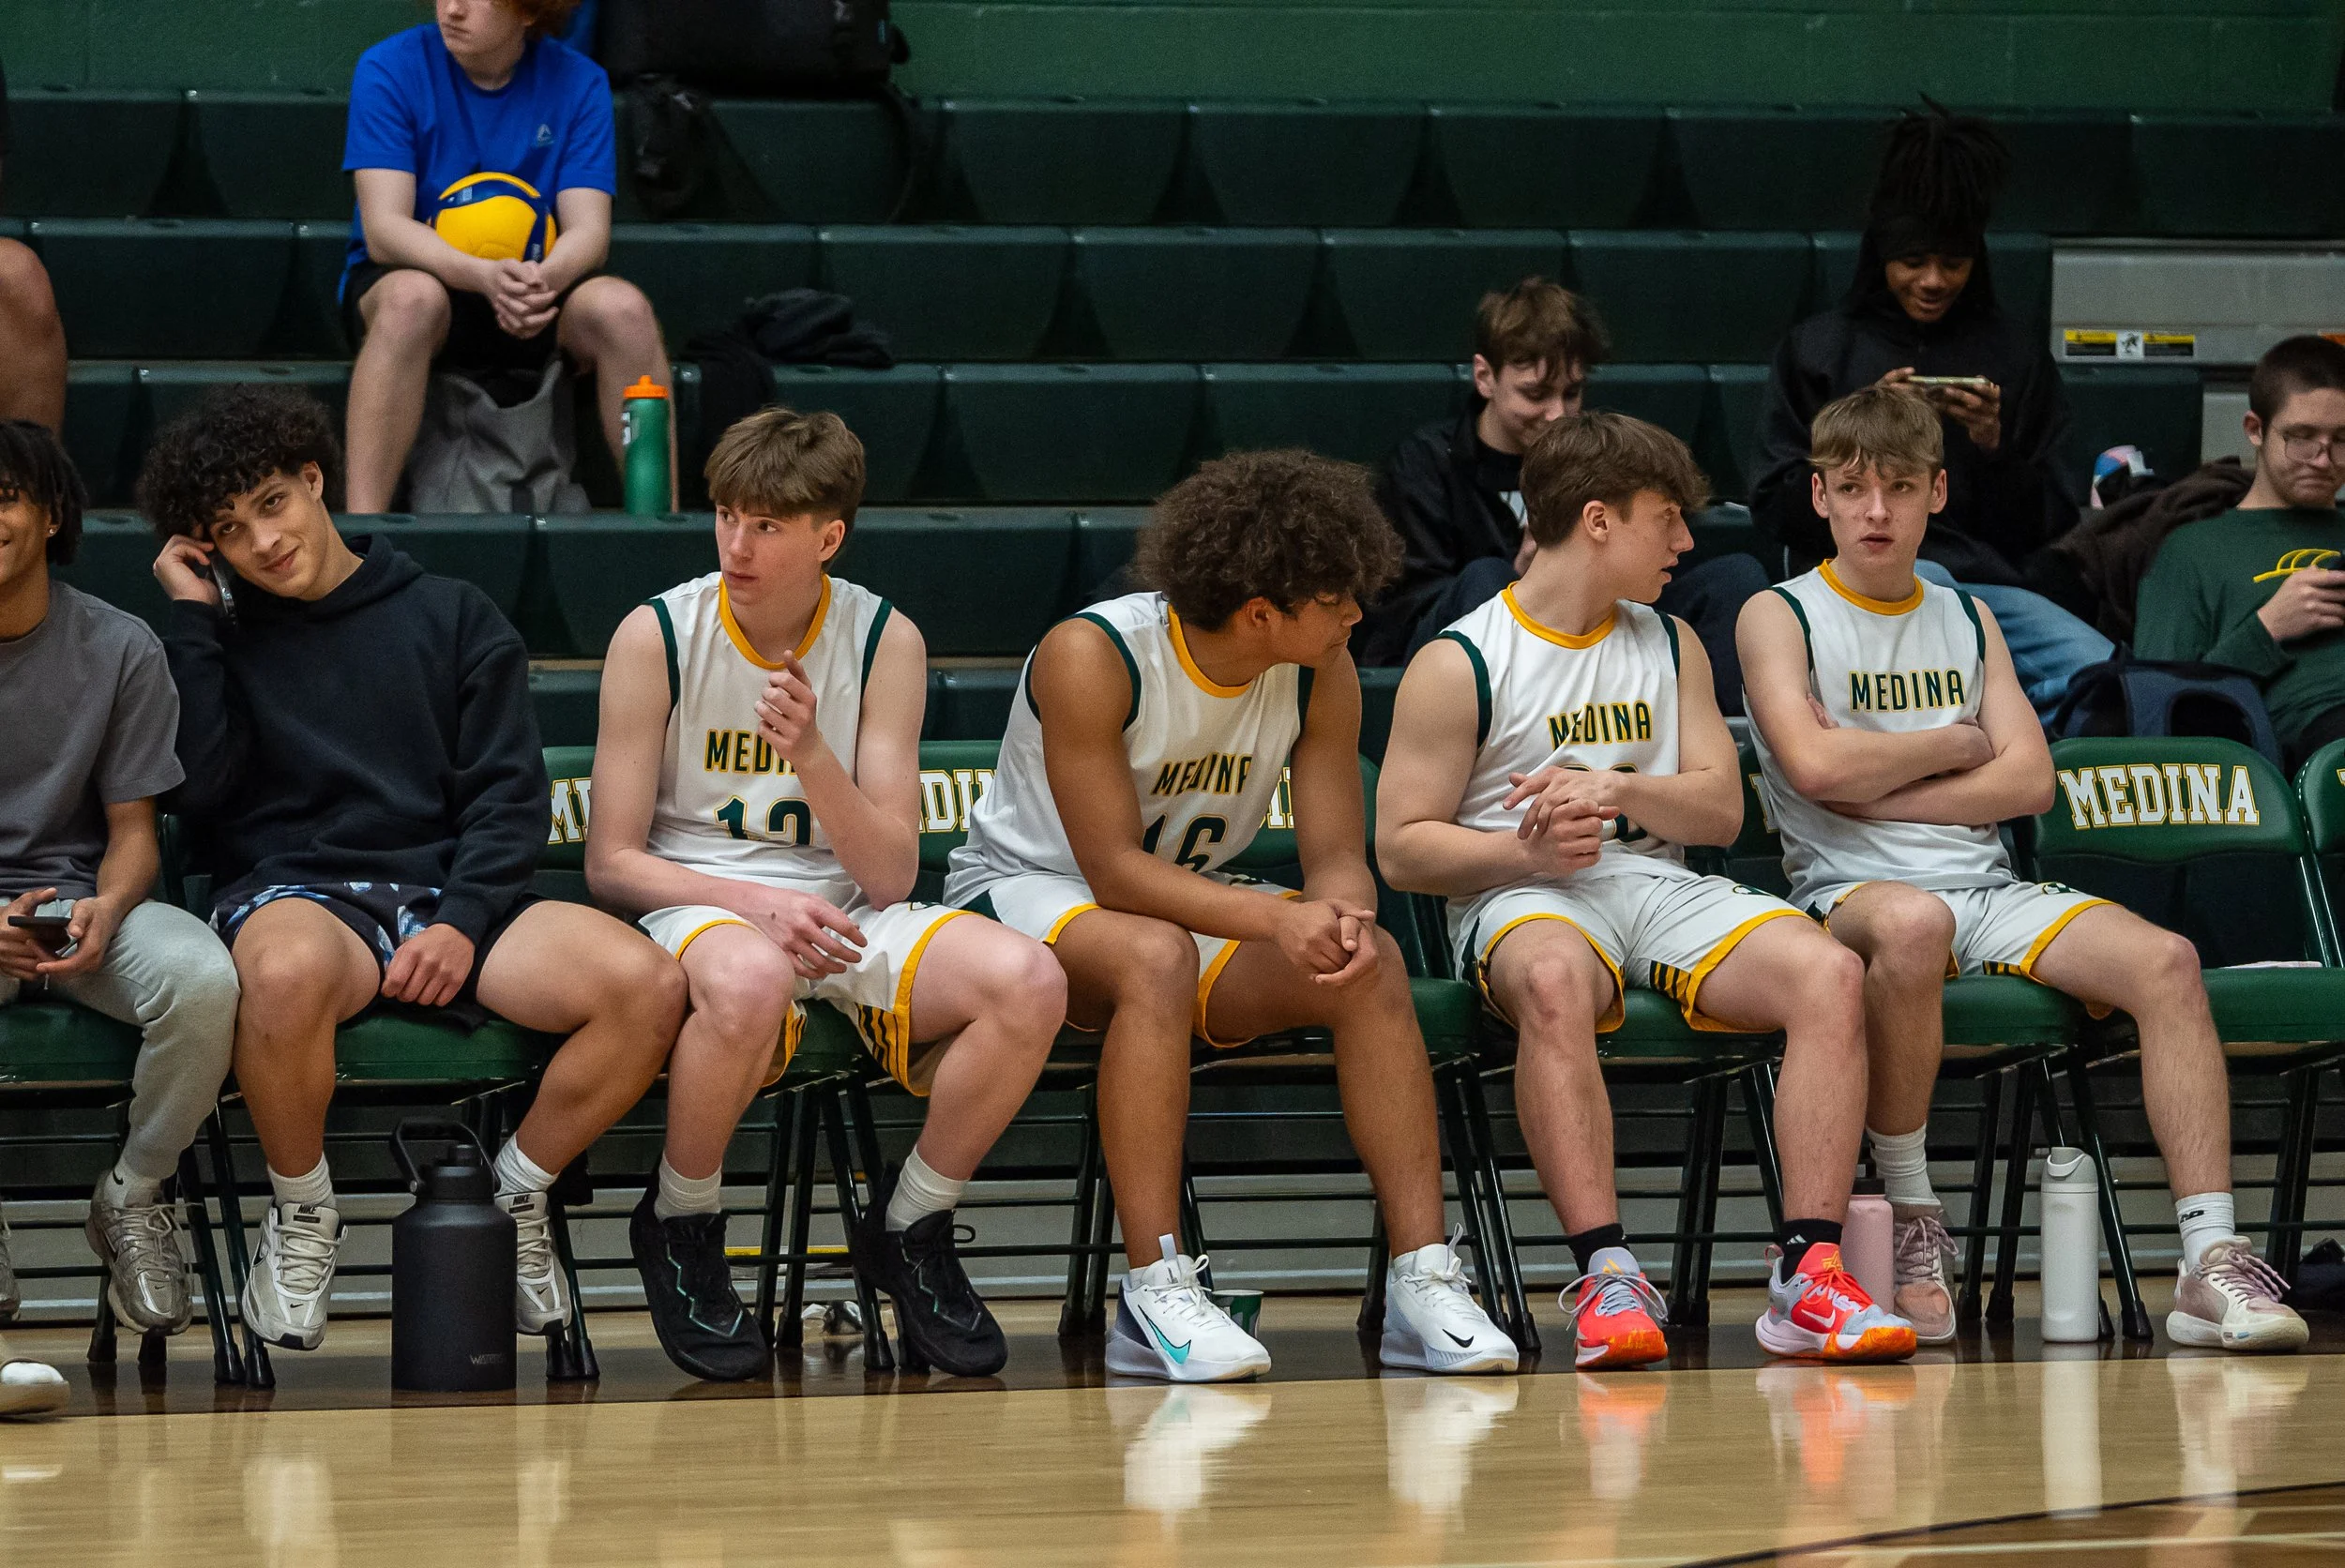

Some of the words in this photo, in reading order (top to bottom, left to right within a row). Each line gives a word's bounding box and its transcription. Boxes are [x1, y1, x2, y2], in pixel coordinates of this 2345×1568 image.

[1849, 669, 1965, 713] MEDINA
[1547, 699, 1653, 750] MEDINA
[704, 729, 798, 776] MED
[2057, 762, 2260, 830] MEDINA
